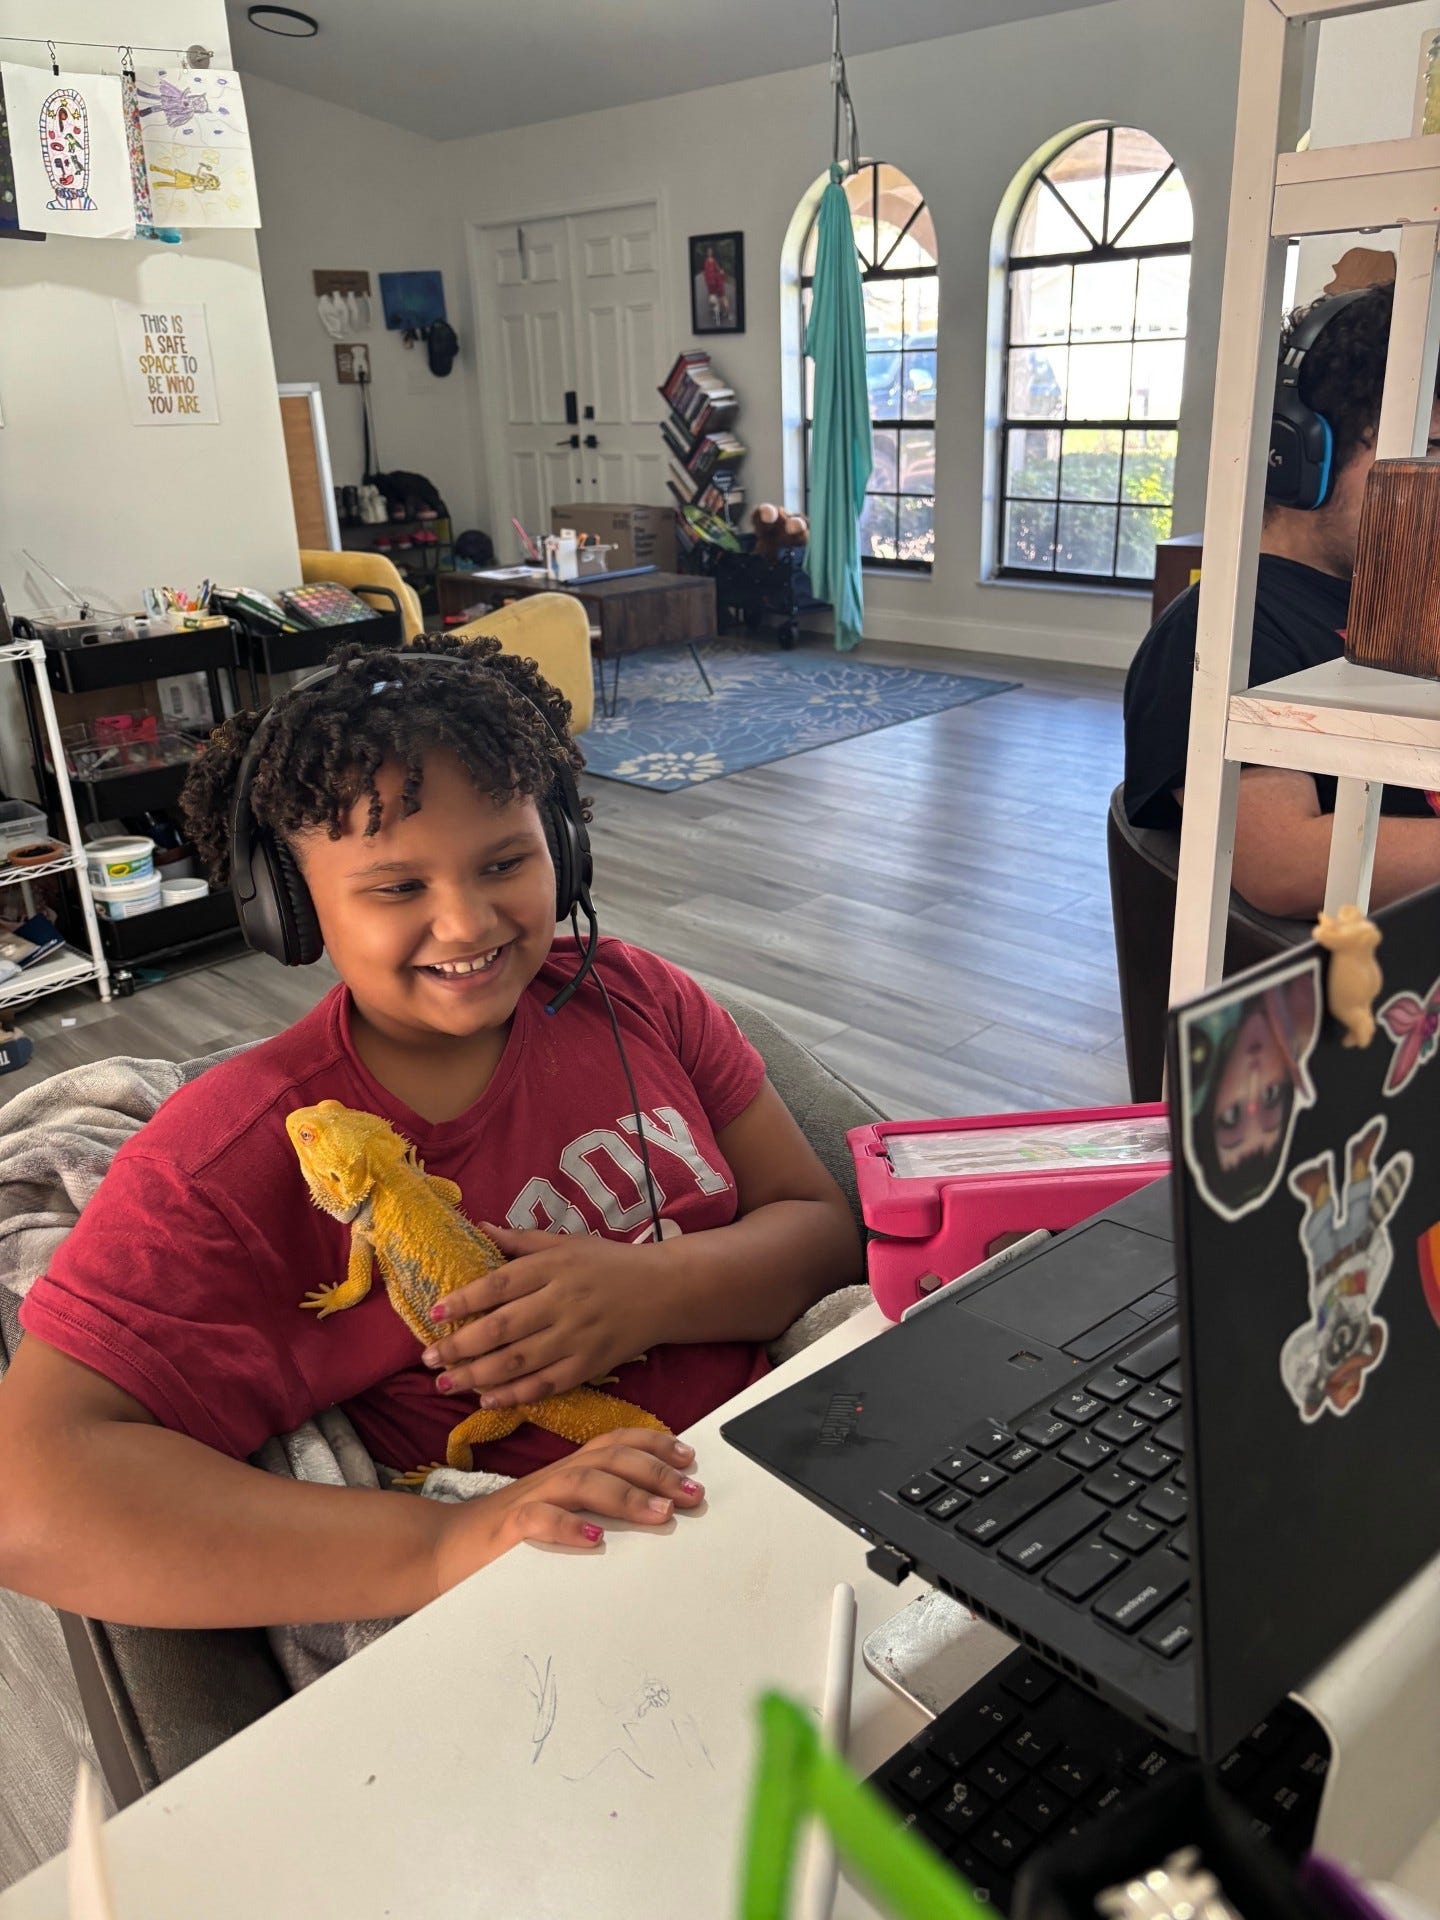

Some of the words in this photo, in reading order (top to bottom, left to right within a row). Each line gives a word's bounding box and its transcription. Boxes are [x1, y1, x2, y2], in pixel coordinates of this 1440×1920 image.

[140, 314, 168, 333] THIS
[171, 315, 183, 333] IS
[144, 335, 155, 353] A
[157, 335, 187, 354] SAFE
[139, 355, 179, 374] SPACE
[181, 355, 198, 374] TO
[147, 375, 163, 394] BE
[165, 375, 195, 394] WHO
[148, 396, 173, 414] YOU
[177, 395, 200, 413] ARE
[1019, 1541, 1042, 1559] Enter
[1115, 1586, 1158, 1618] Backspace
[995, 1773, 1007, 1784] 2
